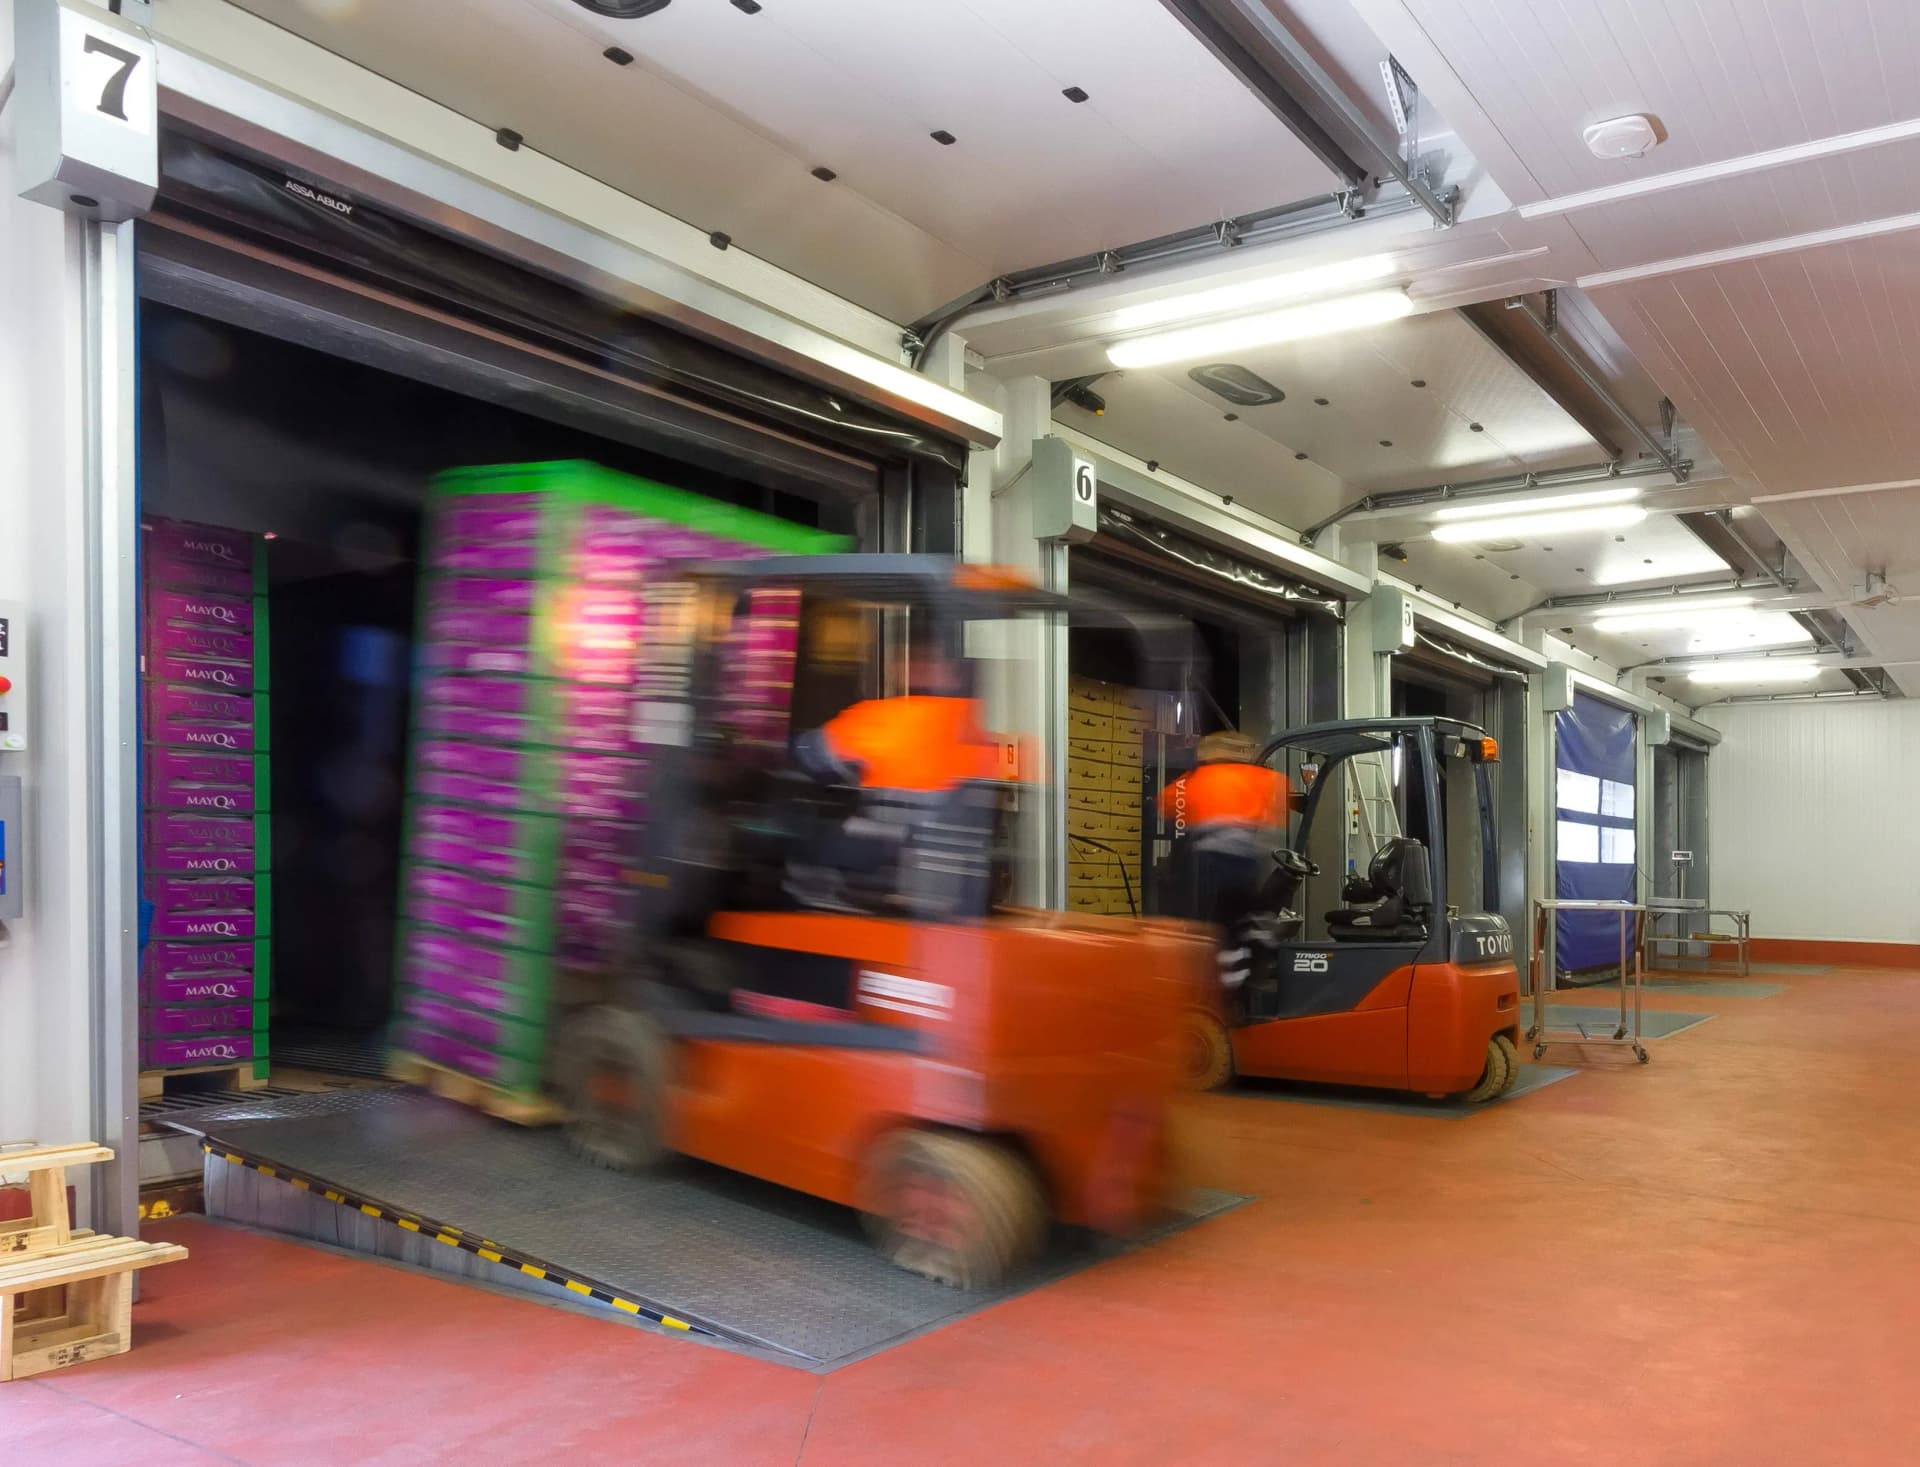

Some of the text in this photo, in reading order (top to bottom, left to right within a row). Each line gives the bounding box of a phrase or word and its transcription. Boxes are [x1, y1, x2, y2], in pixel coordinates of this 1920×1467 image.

[83, 33, 141, 122] 7
[285, 181, 353, 215] ASSA ABLOY
[1076, 465, 1092, 501] 6
[184, 540, 238, 561] MAYQA
[185, 604, 236, 623] MAYQA
[185, 669, 237, 687] MAYQA
[186, 732, 238, 749] MAYQA
[187, 795, 237, 810] MAYQA
[1175, 778, 1186, 839] TOYOTA
[186, 858, 237, 871] MAYQA
[186, 921, 238, 937] MAYQA
[1293, 959, 1329, 972] 20
[185, 983, 238, 998] MAYQA
[185, 1044, 238, 1059] MAYQA
